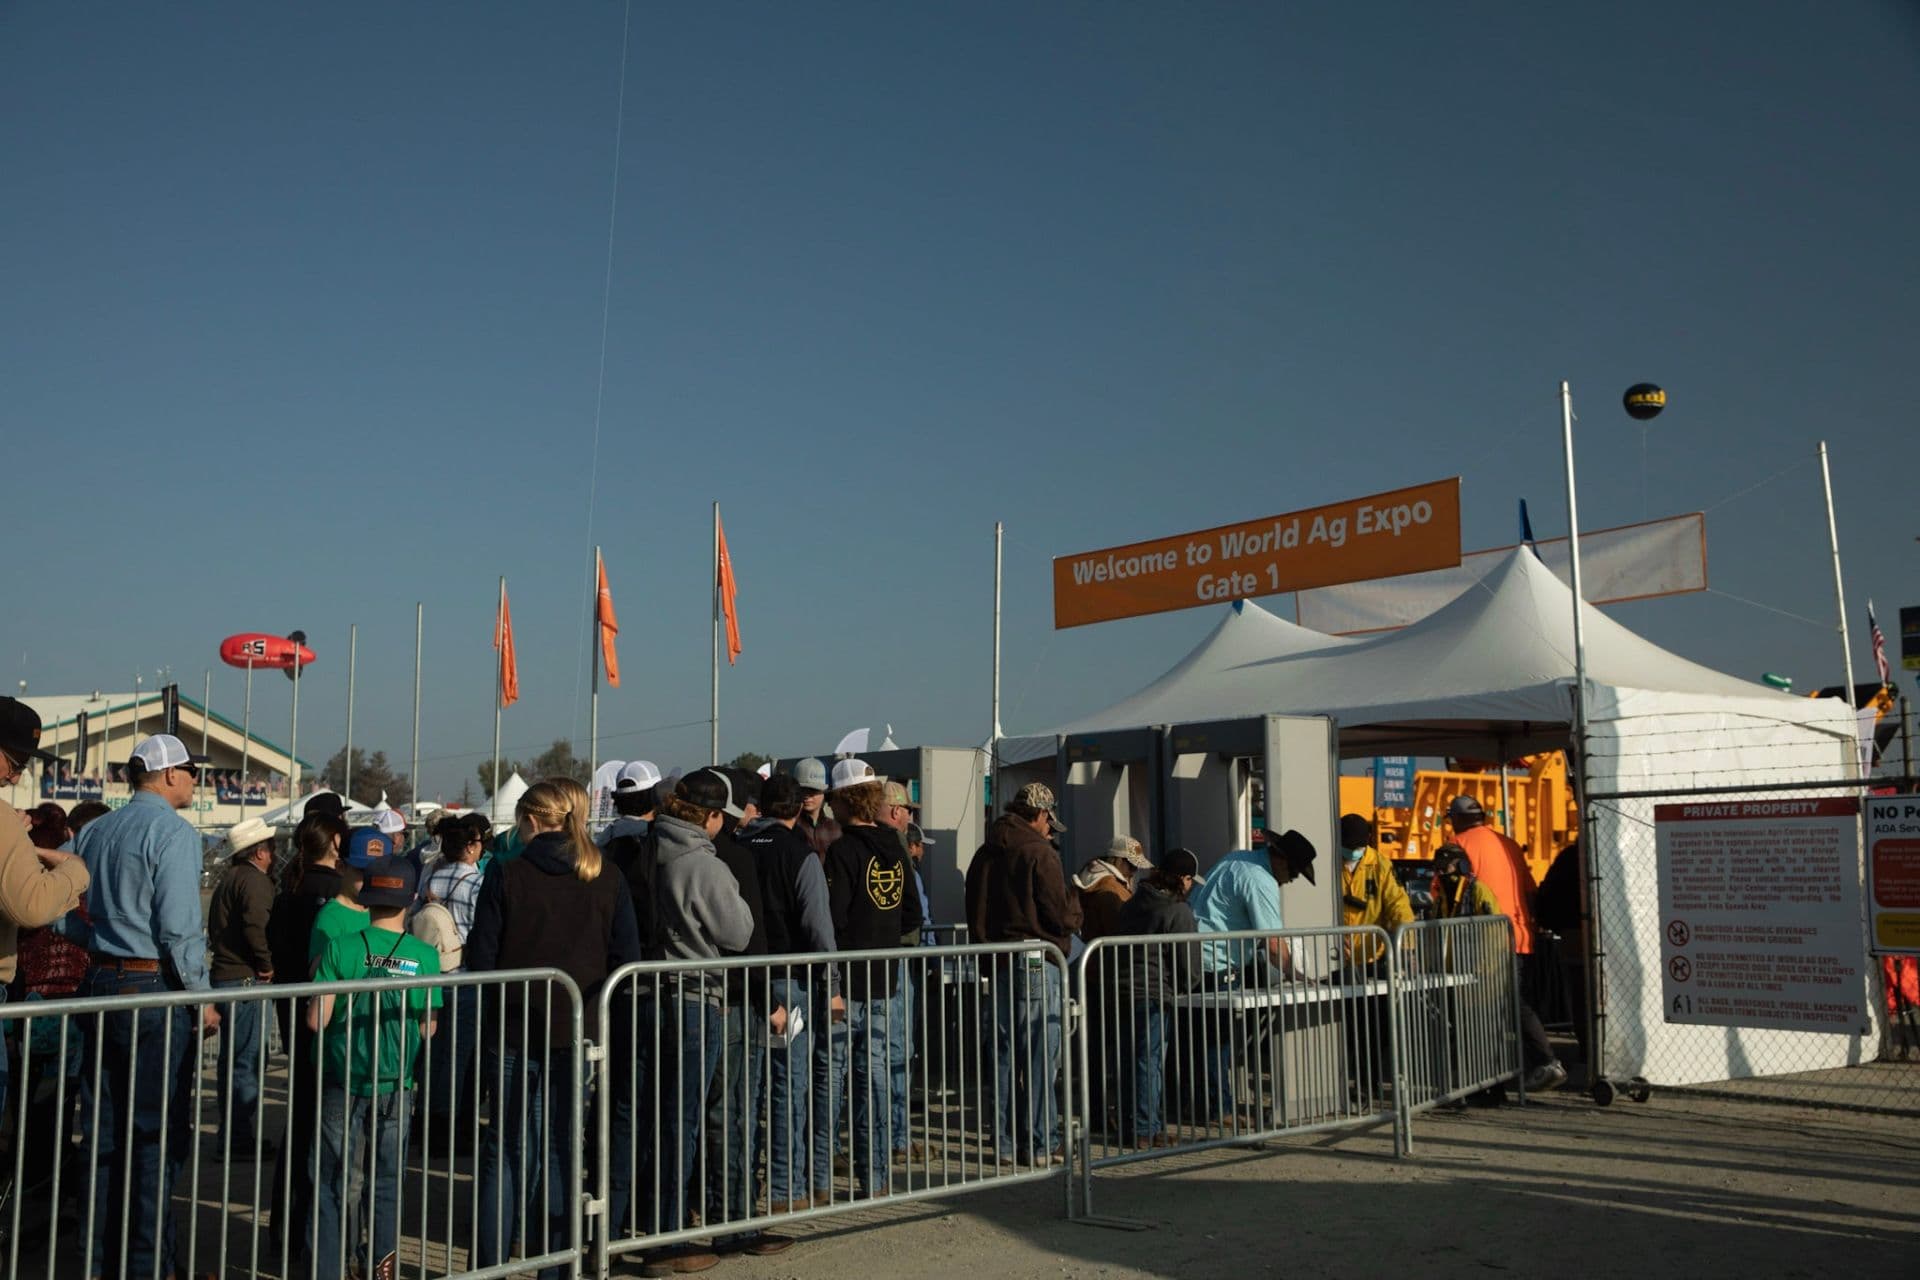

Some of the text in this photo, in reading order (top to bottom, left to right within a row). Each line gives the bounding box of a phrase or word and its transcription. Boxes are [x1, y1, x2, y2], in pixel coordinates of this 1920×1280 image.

[1073, 498, 1433, 586] Welcome to World Ag Expo
[1196, 563, 1279, 601] Gate 1
[1684, 802, 1820, 817] PRIVATE PROPERTY
[1874, 806, 1898, 820] NO
[1875, 824, 1896, 834] ADA
